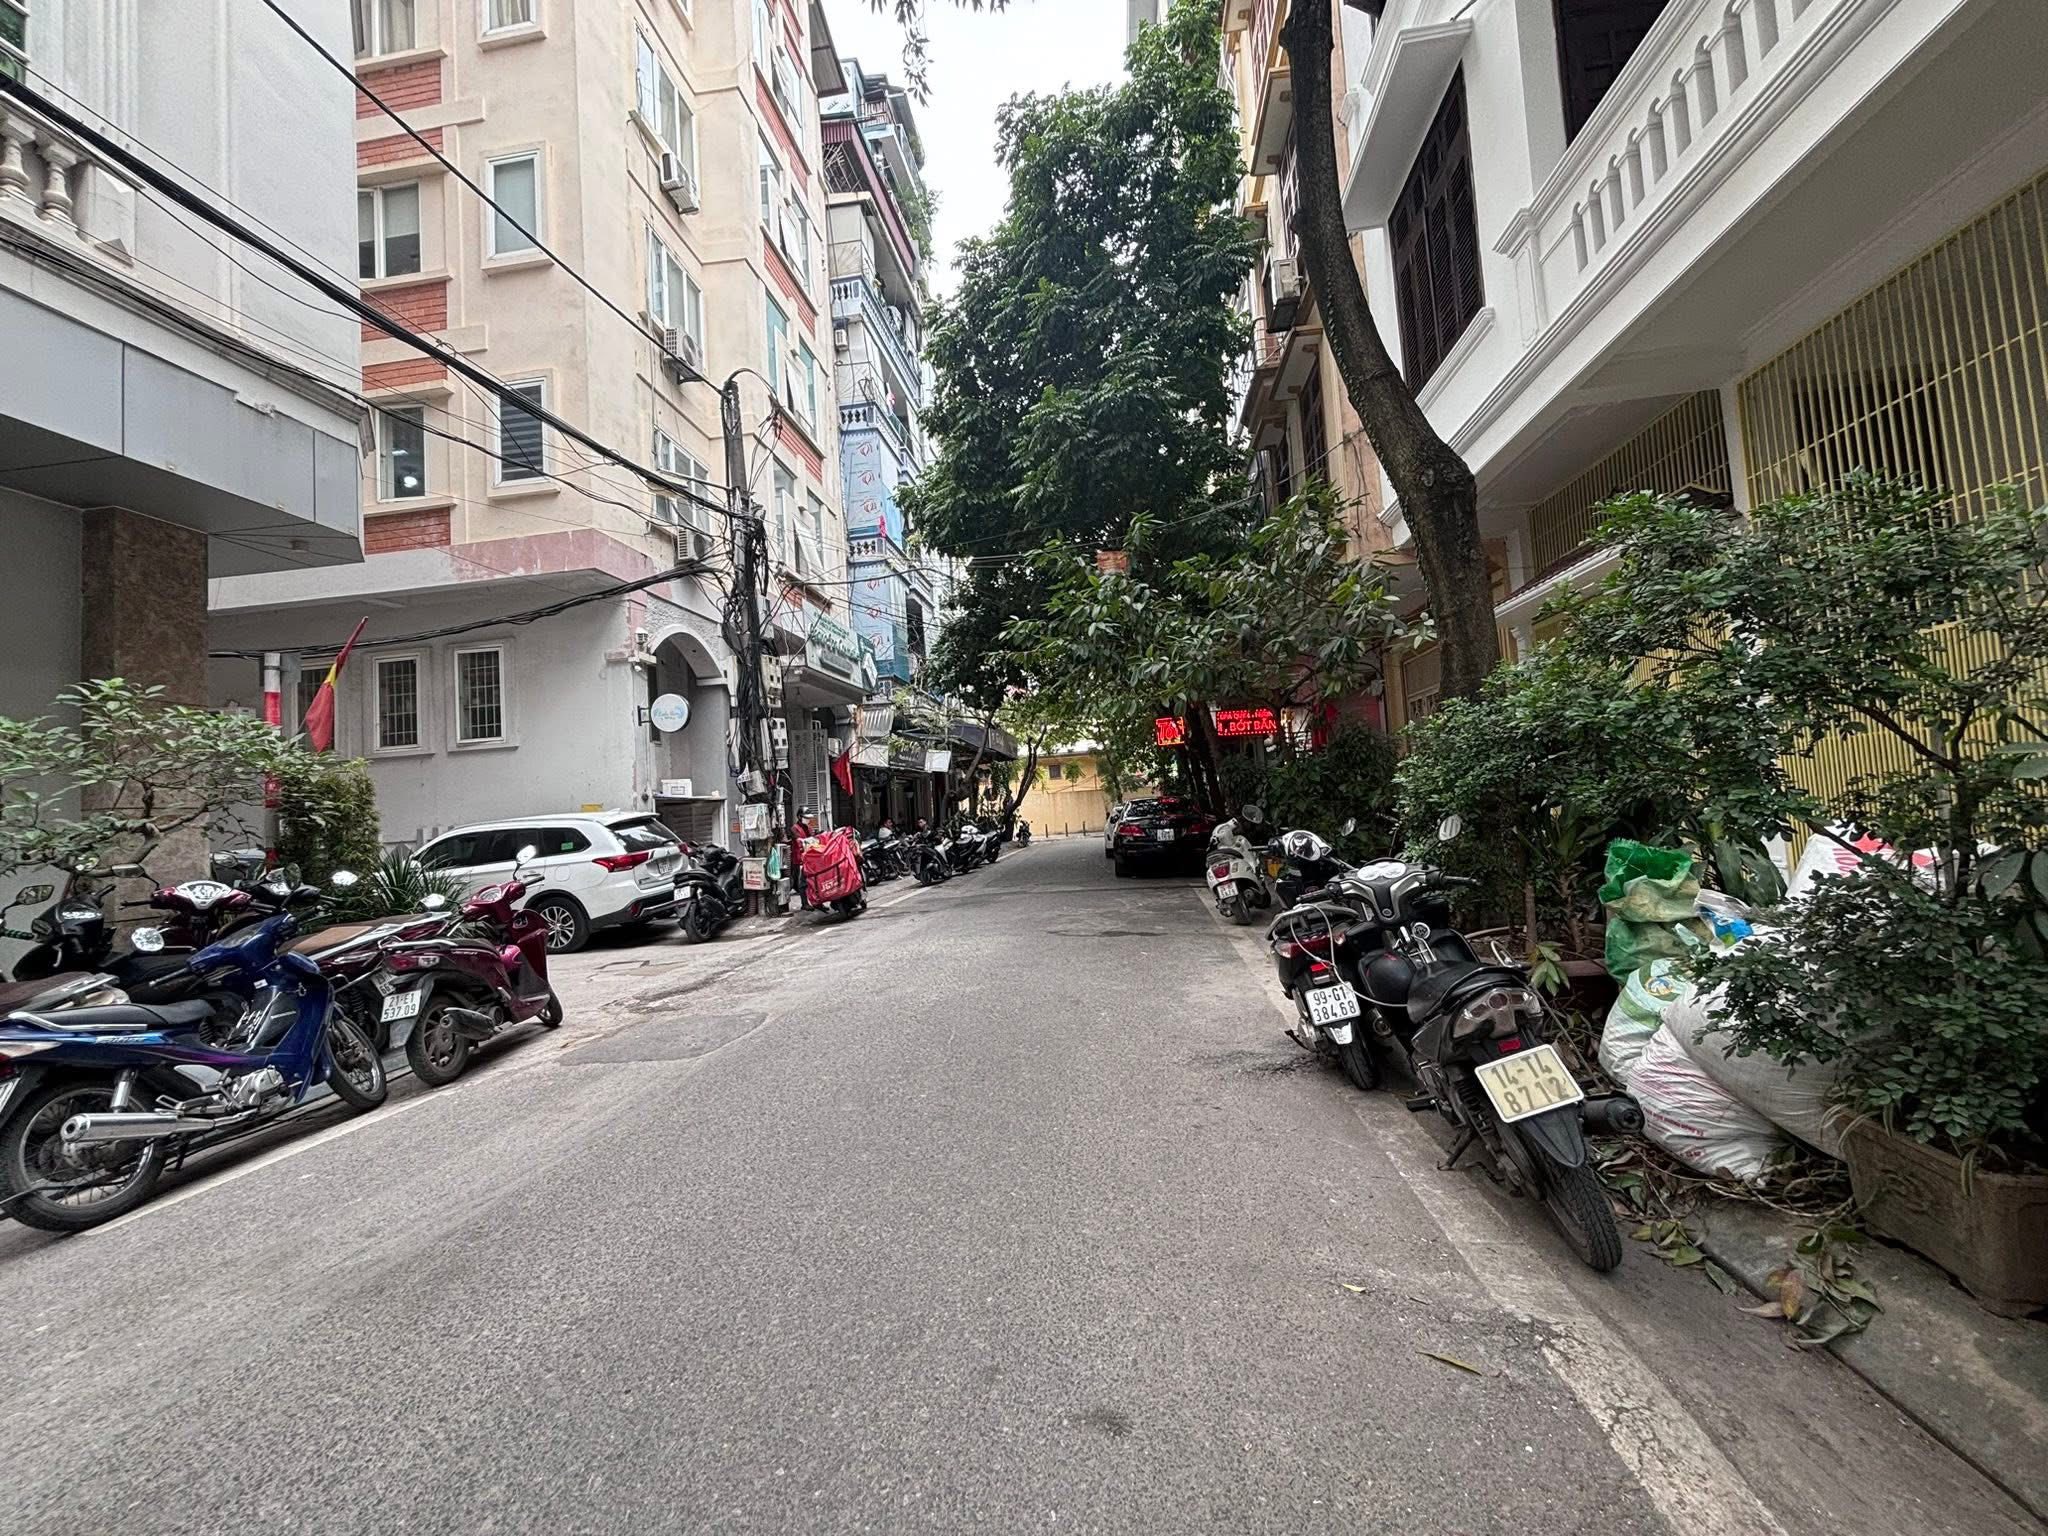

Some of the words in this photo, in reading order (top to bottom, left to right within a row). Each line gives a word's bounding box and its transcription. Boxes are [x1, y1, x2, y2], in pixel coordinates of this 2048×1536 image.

[389, 993, 415, 1008] 21-E1
[1313, 986, 1347, 1006] 99-G1
[383, 1003, 417, 1020] 537.09
[1313, 1000, 1356, 1022] 384.68
[1491, 1053, 1553, 1089] 14-T4
[1503, 1077, 1570, 1114] 8712
